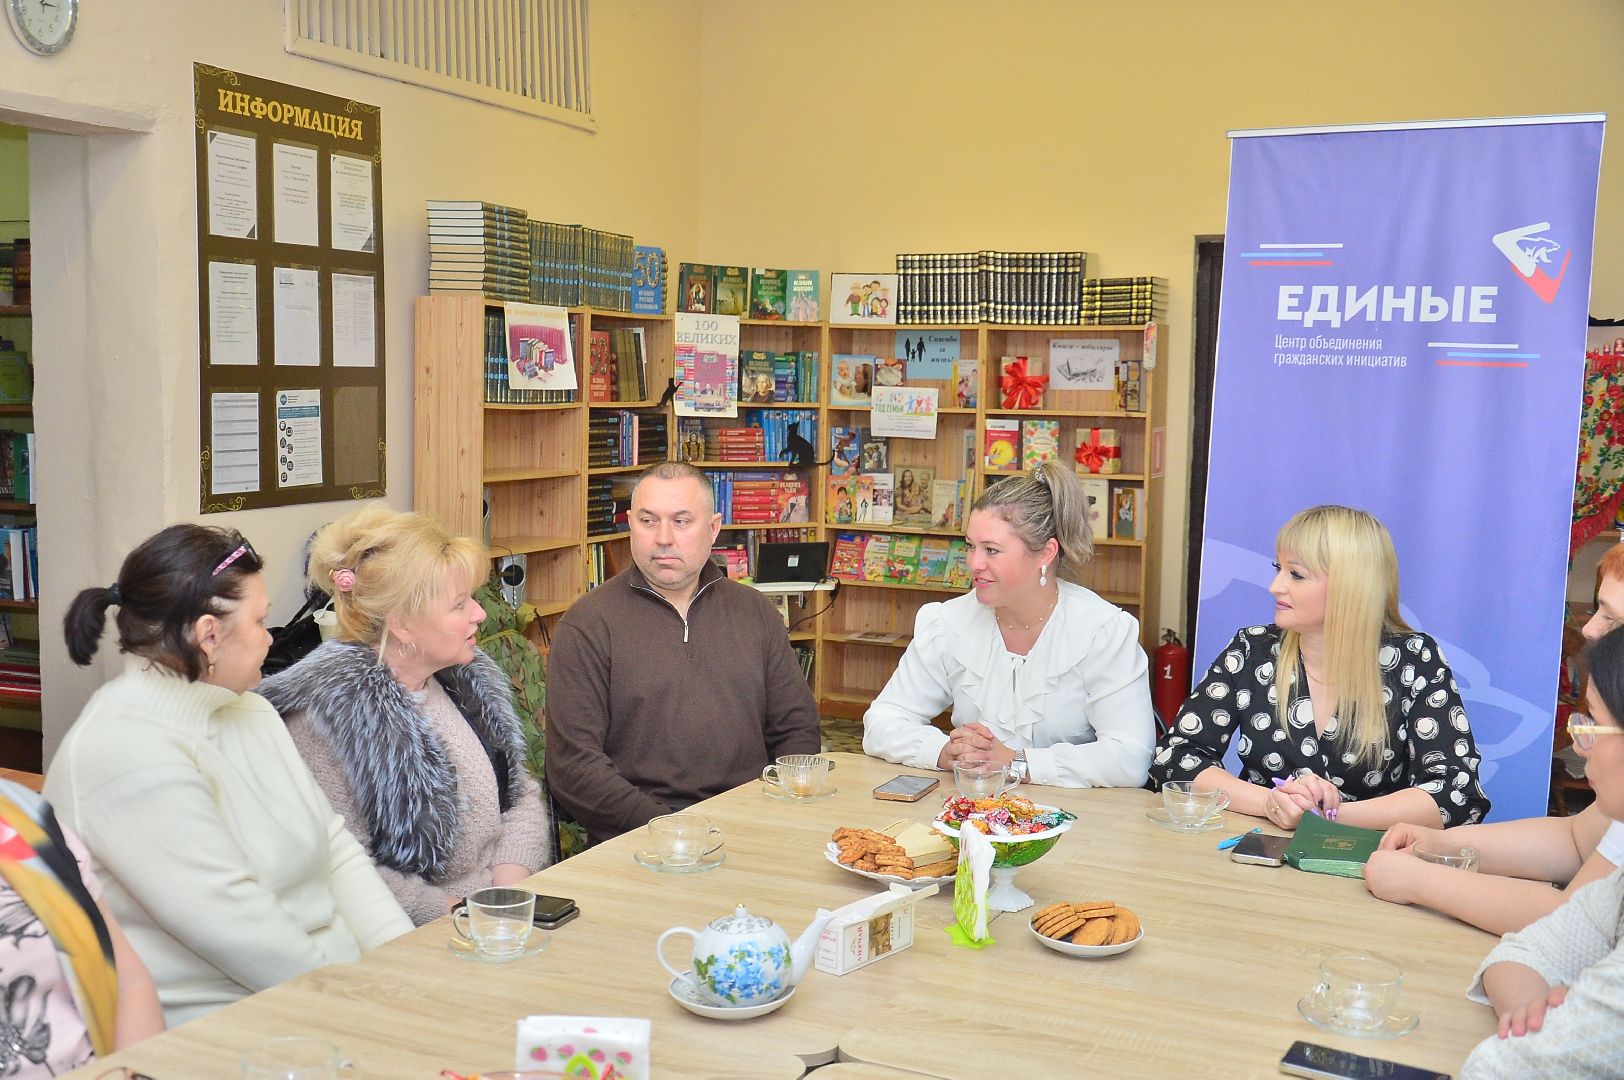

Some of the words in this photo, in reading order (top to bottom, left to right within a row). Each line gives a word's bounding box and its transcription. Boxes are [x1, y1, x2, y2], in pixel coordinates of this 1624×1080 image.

[218, 88, 363, 140] ИНФОРМАЦИЯ
[1276, 284, 1499, 329] ЕДИНЫЕ
[694, 319, 719, 331] 100
[676, 332, 738, 345] ВЕЛИКИХ
[928, 335, 958, 343] Спасибо
[1274, 333, 1307, 350] Центр
[1309, 334, 1383, 351] объединения
[1273, 350, 1344, 367] гражданских
[1346, 352, 1408, 368] инициатив
[1163, 663, 1173, 680] 1
